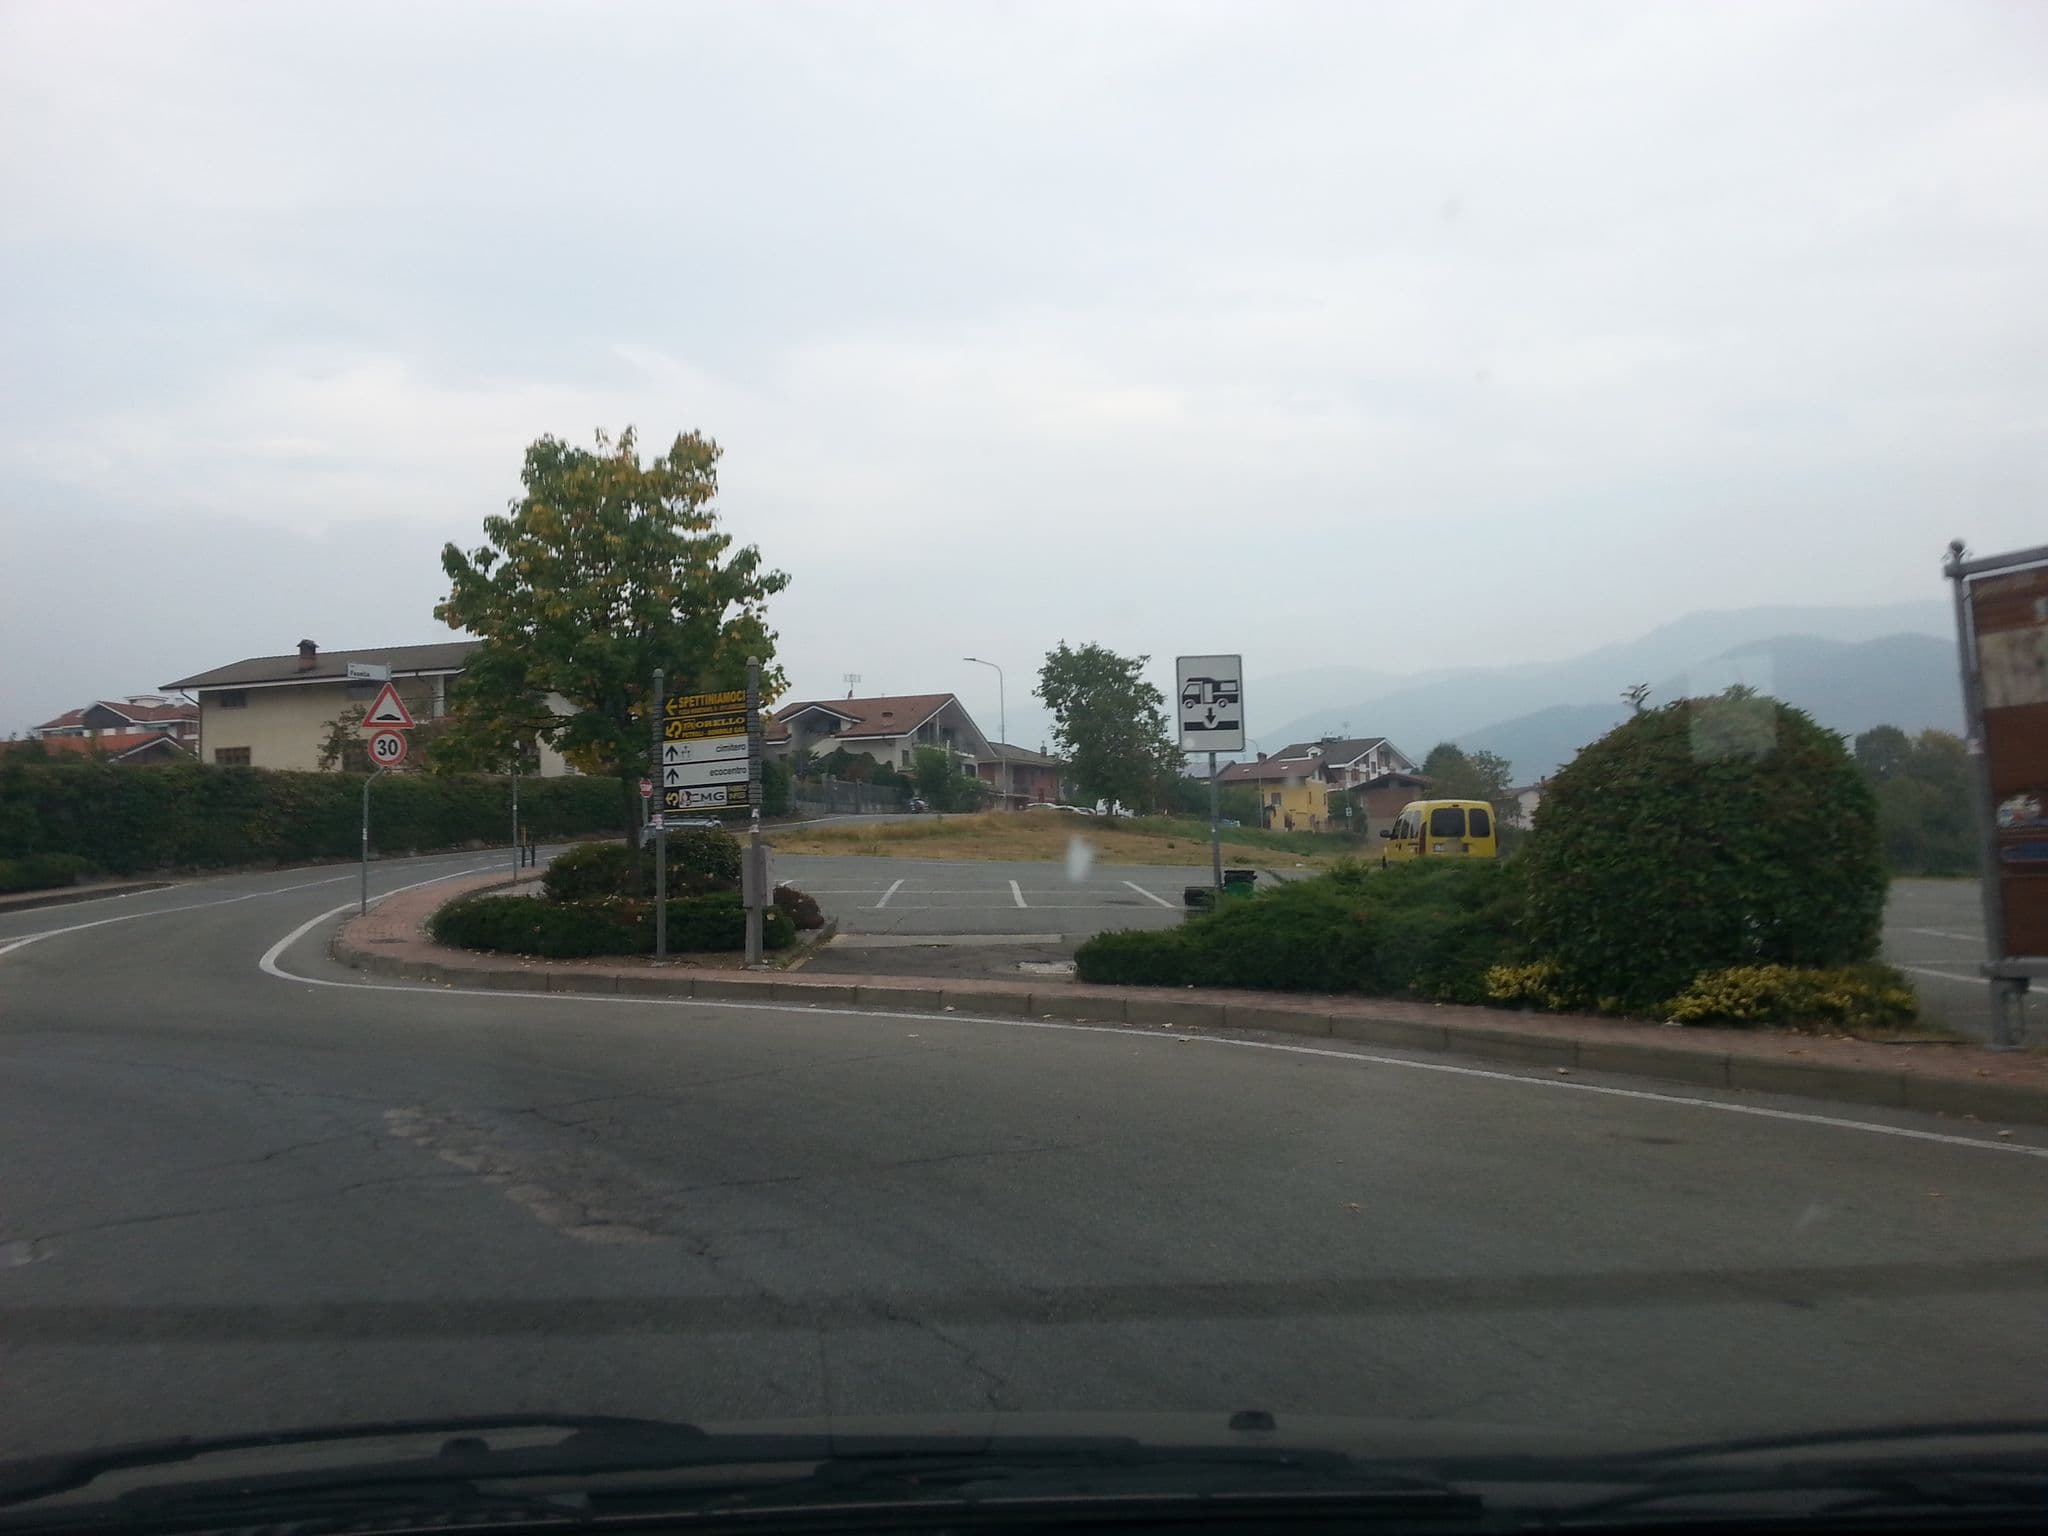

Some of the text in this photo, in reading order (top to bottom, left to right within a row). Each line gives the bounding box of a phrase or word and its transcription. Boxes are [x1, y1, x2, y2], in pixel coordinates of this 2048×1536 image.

[679, 691, 746, 707] SPETTINIAMOCI
[377, 739, 398, 756] 30
[716, 744, 746, 752] cimitero
[710, 767, 746, 776] ecocentro
